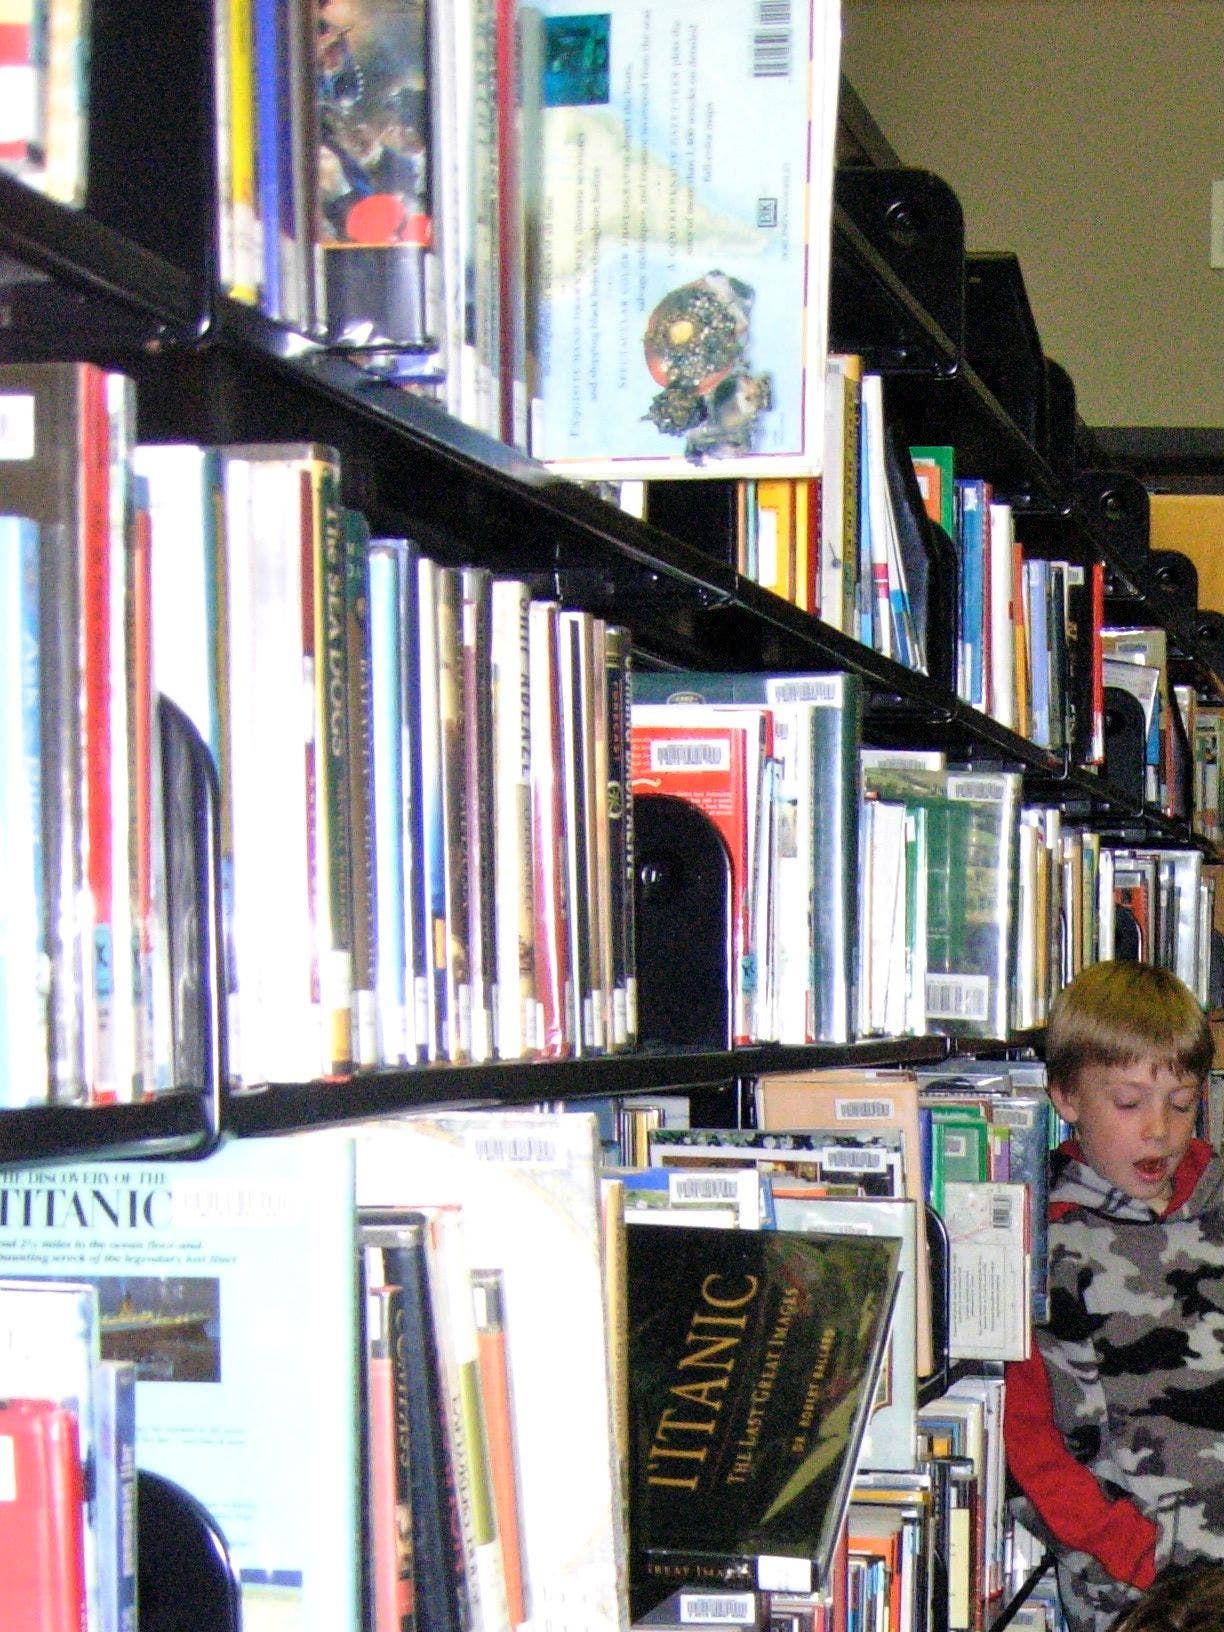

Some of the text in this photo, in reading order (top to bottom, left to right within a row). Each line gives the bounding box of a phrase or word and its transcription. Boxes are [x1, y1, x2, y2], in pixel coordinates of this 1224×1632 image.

[140, 1172, 166, 1186] THE
[769, 1287, 800, 1347] IMAGES
[648, 1272, 760, 1491] TITANIC
[752, 1354, 781, 1402] GREAT
[738, 1406, 767, 1449] LAST
